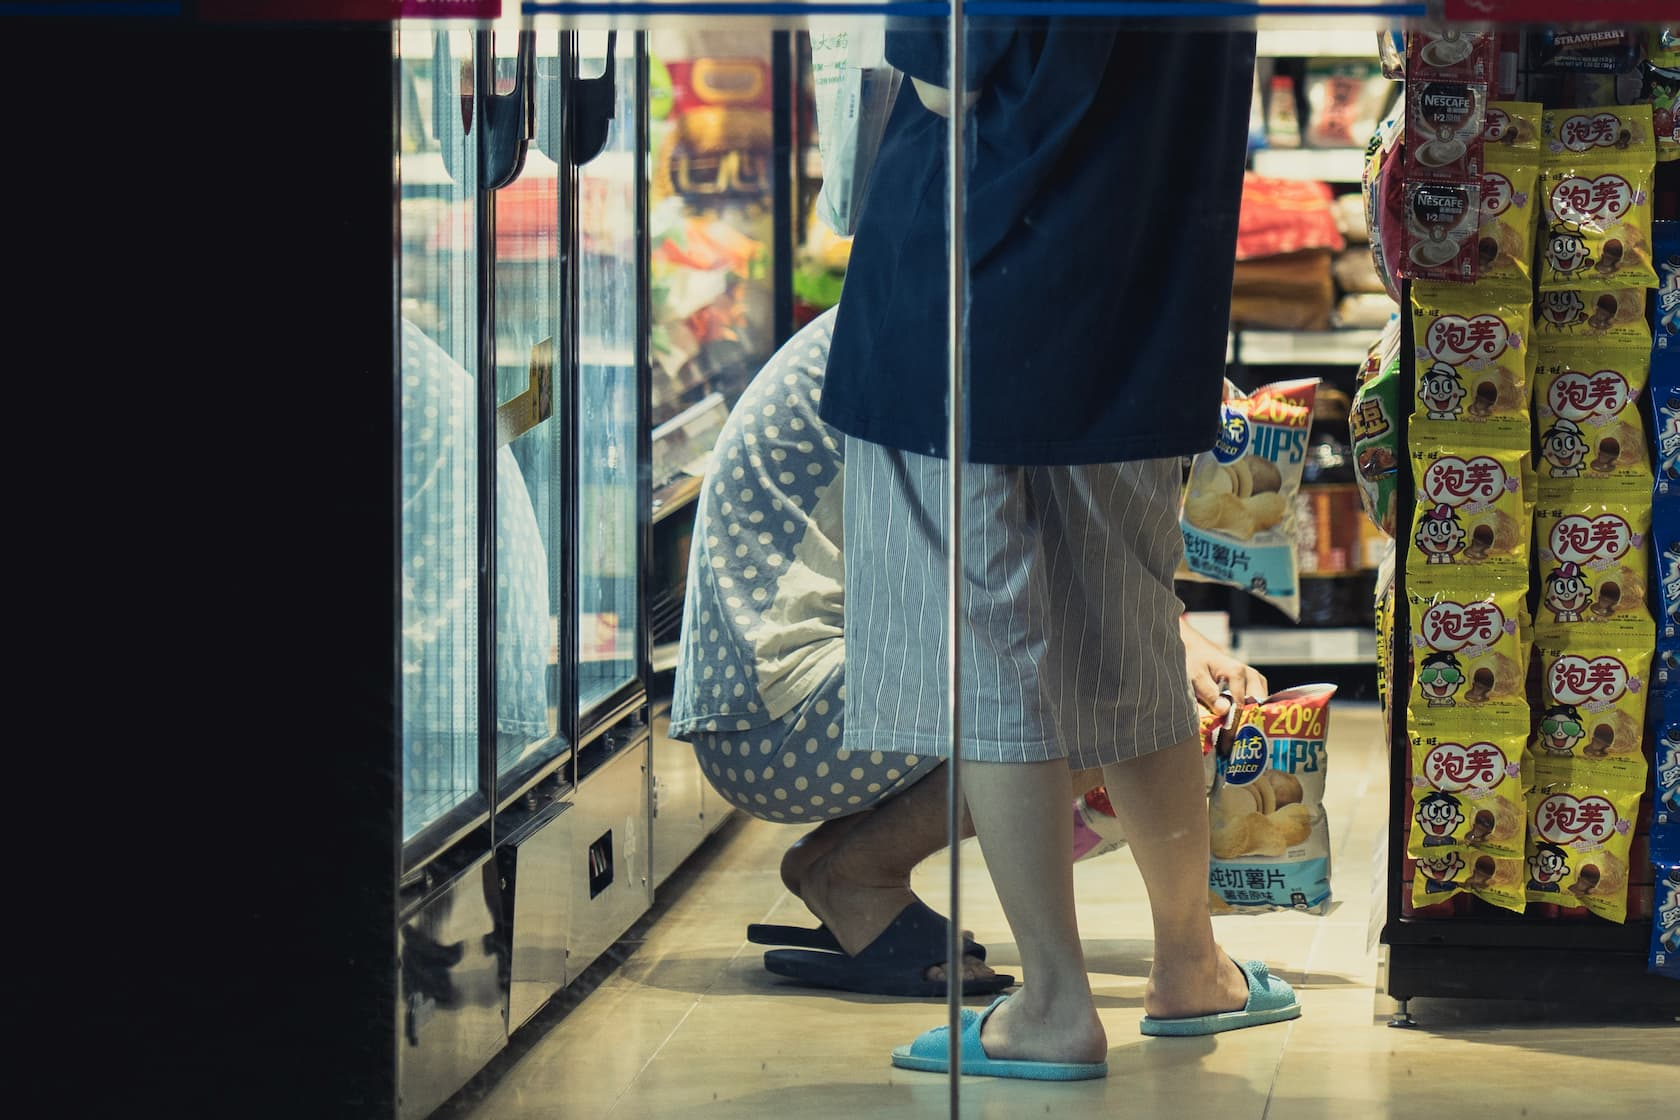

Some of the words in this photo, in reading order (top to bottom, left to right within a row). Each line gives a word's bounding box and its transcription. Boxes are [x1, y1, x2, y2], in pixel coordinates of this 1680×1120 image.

[1554, 29, 1625, 46] STRAWBERRY
[1567, 117, 1620, 142] 泡芙
[1559, 179, 1625, 213] 泡芙
[1435, 321, 1500, 357] 泡芙
[1557, 378, 1621, 412] 泡芙
[1251, 425, 1307, 465] HIPS
[1433, 464, 1498, 497] 泡芙
[1559, 521, 1624, 556] 泡芙
[1431, 609, 1496, 642] 泡芙
[1555, 662, 1621, 696] 泡芙
[1269, 704, 1321, 735] 20%
[1269, 739, 1323, 774] HIPS
[1434, 750, 1498, 783] 泡芙
[1544, 801, 1610, 835] 泡芙
[1210, 868, 1286, 889] 纯切薯片
